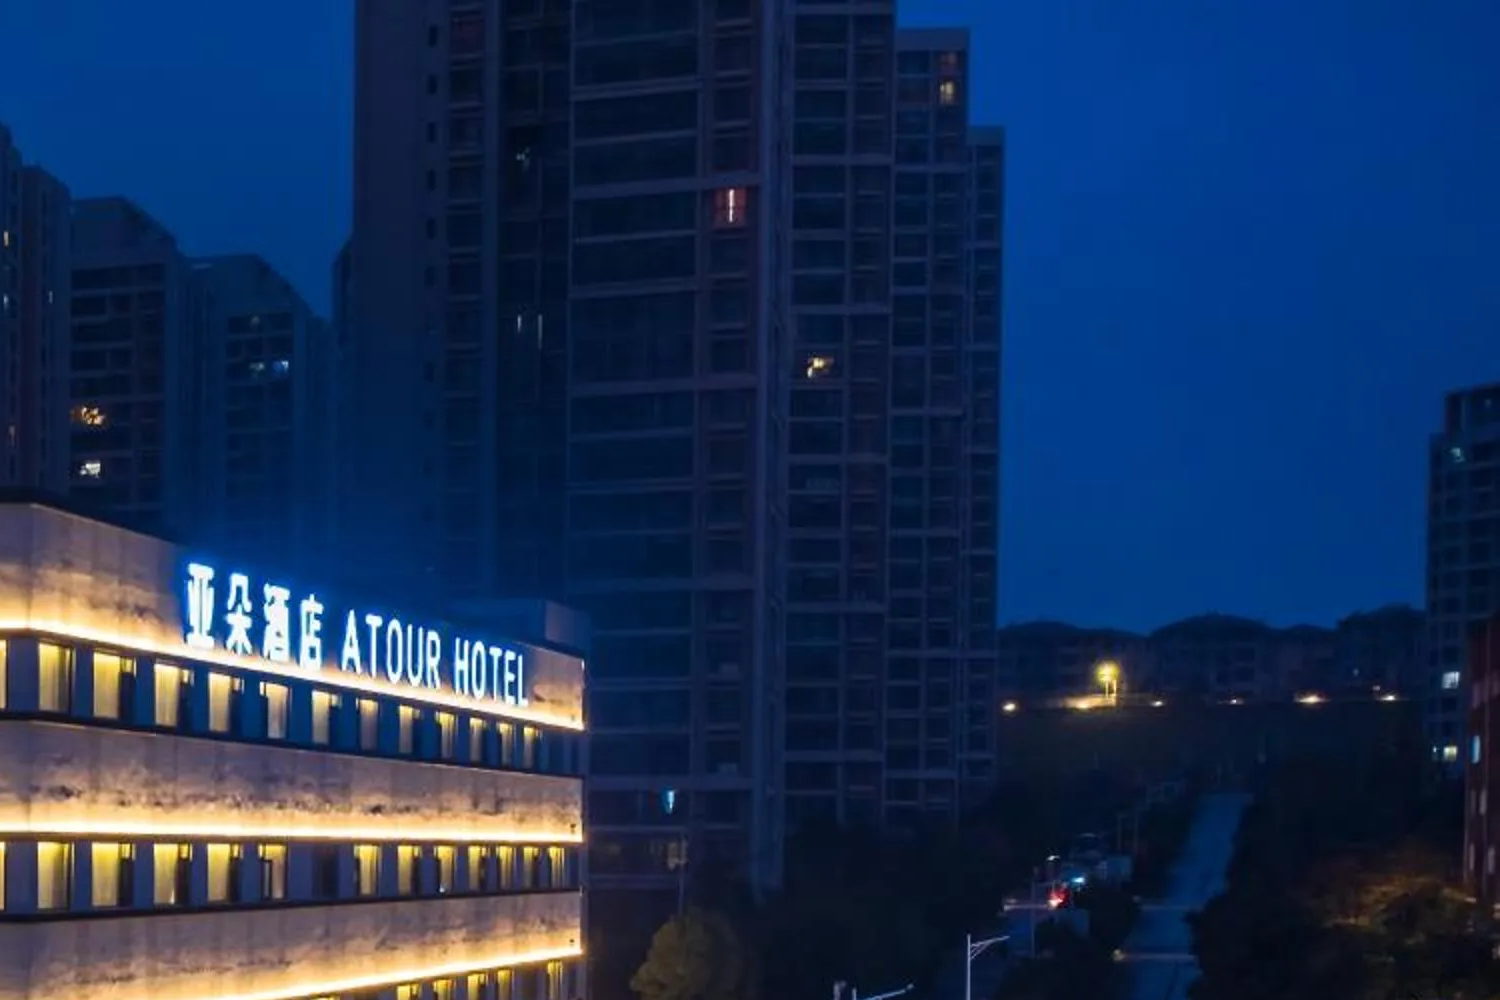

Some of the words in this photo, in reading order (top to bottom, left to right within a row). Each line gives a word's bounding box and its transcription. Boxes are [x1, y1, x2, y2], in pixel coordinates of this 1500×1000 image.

[187, 563, 324, 671] 亚朵酒店
[342, 609, 441, 689] ATOUR
[455, 637, 529, 706] HOTEL
